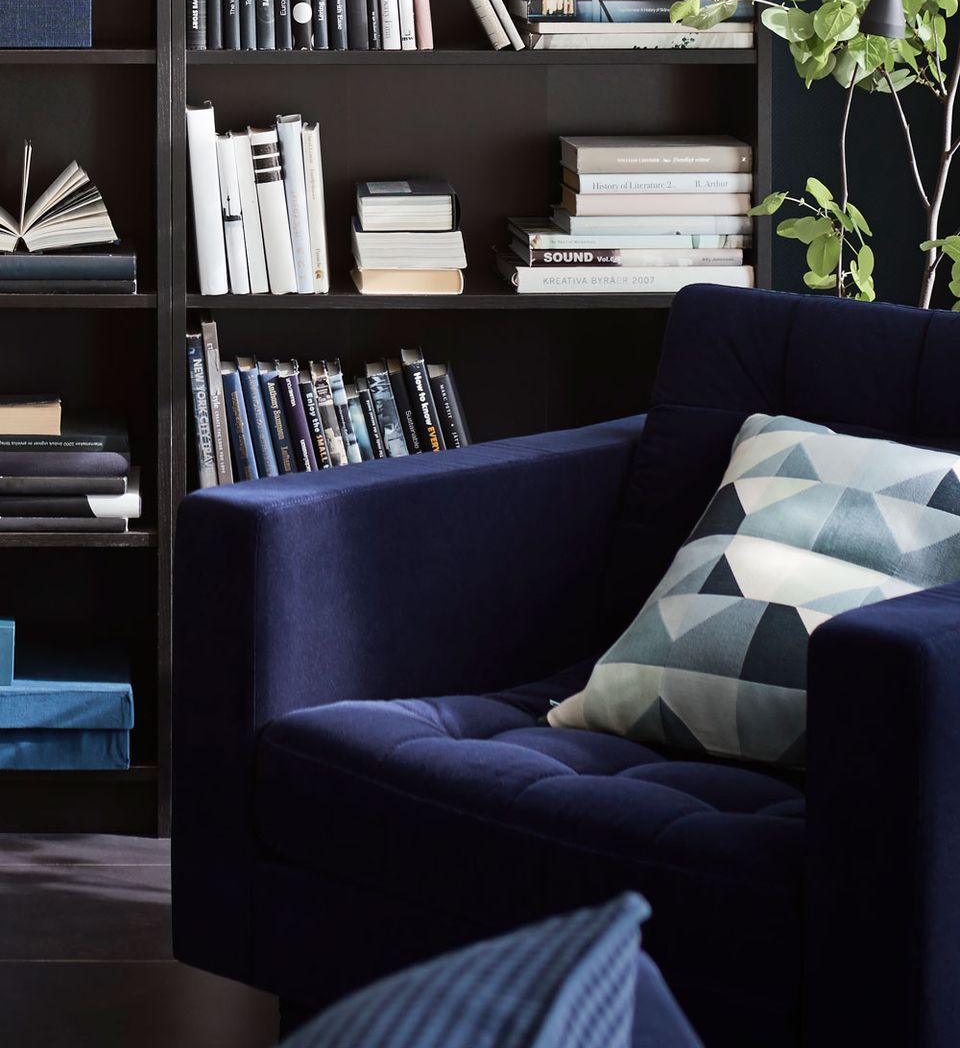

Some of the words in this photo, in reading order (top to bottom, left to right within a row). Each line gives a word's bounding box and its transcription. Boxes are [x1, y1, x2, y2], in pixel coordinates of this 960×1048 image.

[592, 182, 618, 192] History
[543, 252, 594, 263] SOUND
[591, 275, 628, 285] BYRÅER
[632, 276, 655, 285] 2007
[192, 358, 206, 382] NEW
[196, 385, 209, 415] YORK
[198, 417, 211, 443] CITY
